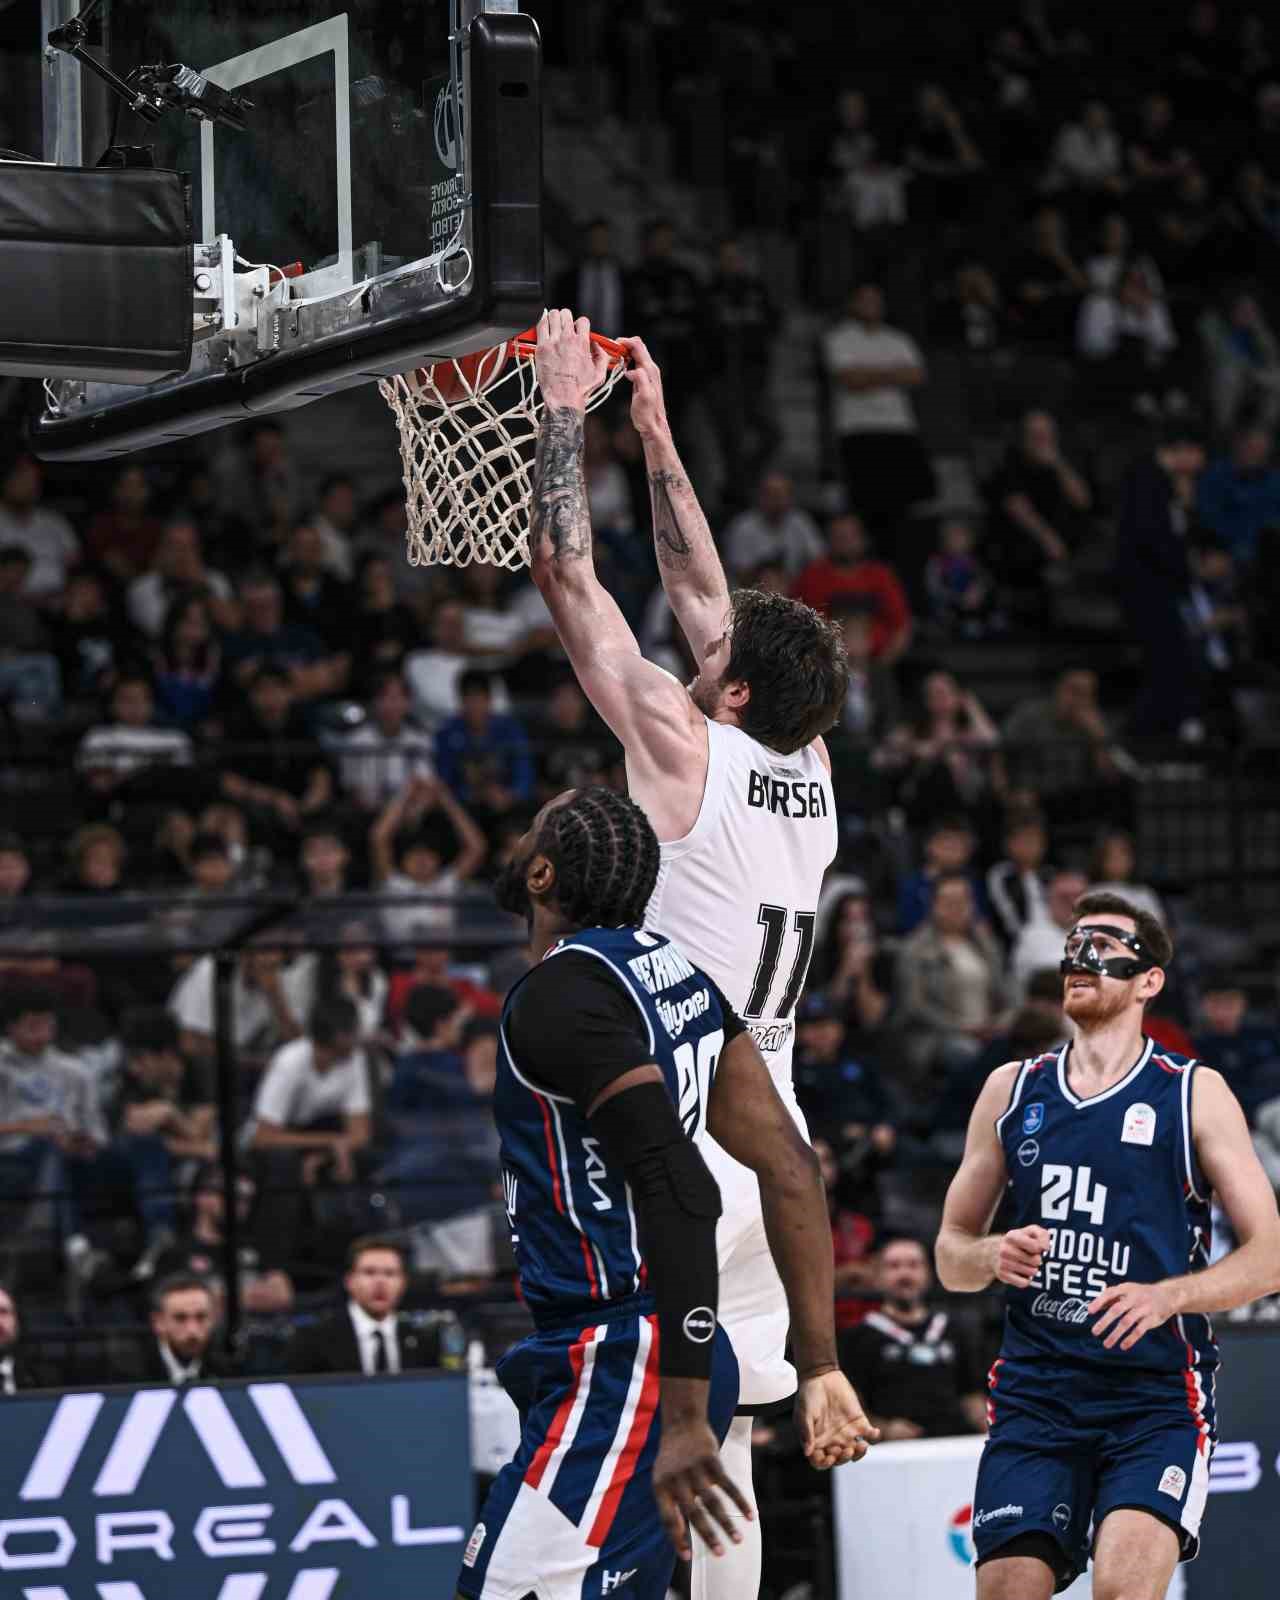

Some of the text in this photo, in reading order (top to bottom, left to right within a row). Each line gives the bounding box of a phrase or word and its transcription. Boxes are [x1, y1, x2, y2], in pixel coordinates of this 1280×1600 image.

[743, 903, 816, 1018] 11
[1041, 1164, 1108, 1225] 24
[1043, 1227, 1131, 1276] ADOLU
[1208, 1440, 1280, 1494] B
